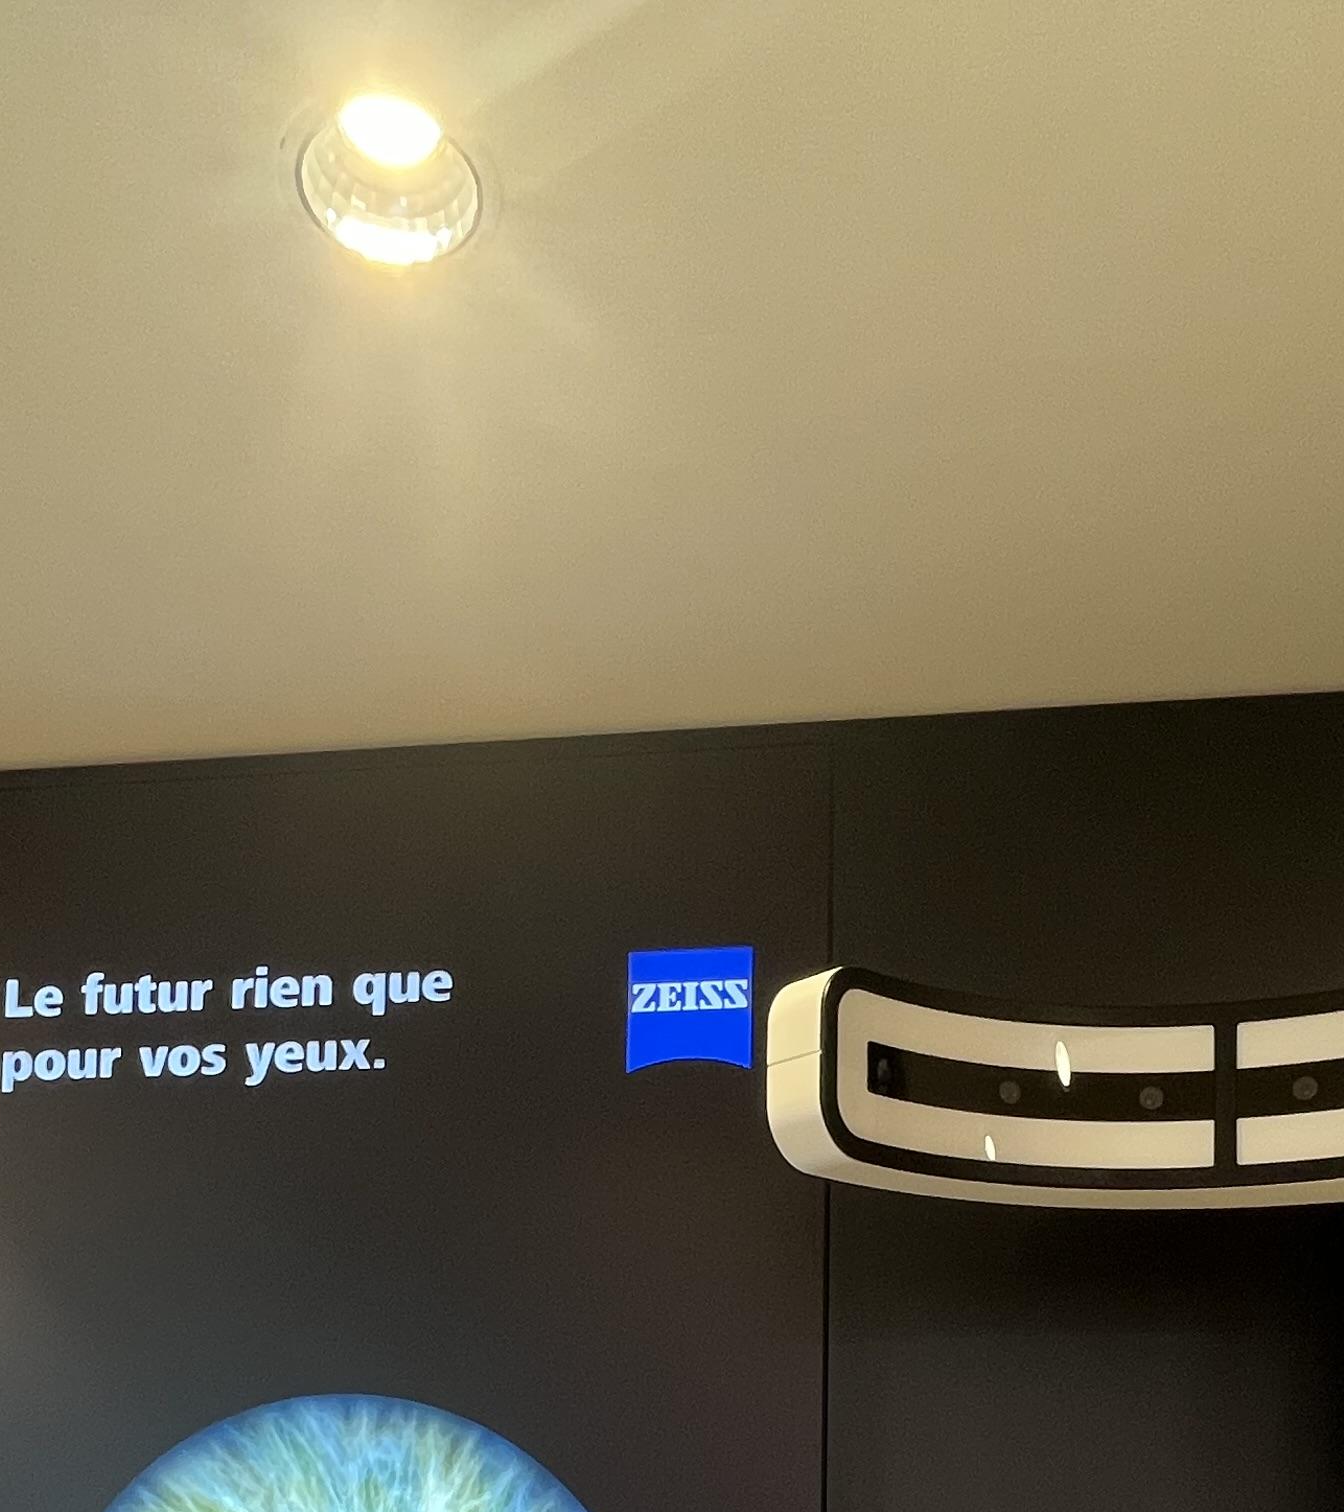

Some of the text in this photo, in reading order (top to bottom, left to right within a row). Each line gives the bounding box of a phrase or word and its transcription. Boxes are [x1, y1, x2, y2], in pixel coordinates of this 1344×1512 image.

[4, 965, 454, 1018] Le futur rien que
[630, 978, 750, 1013] ZEISS
[1, 1038, 386, 1094] pour vos yeux.
